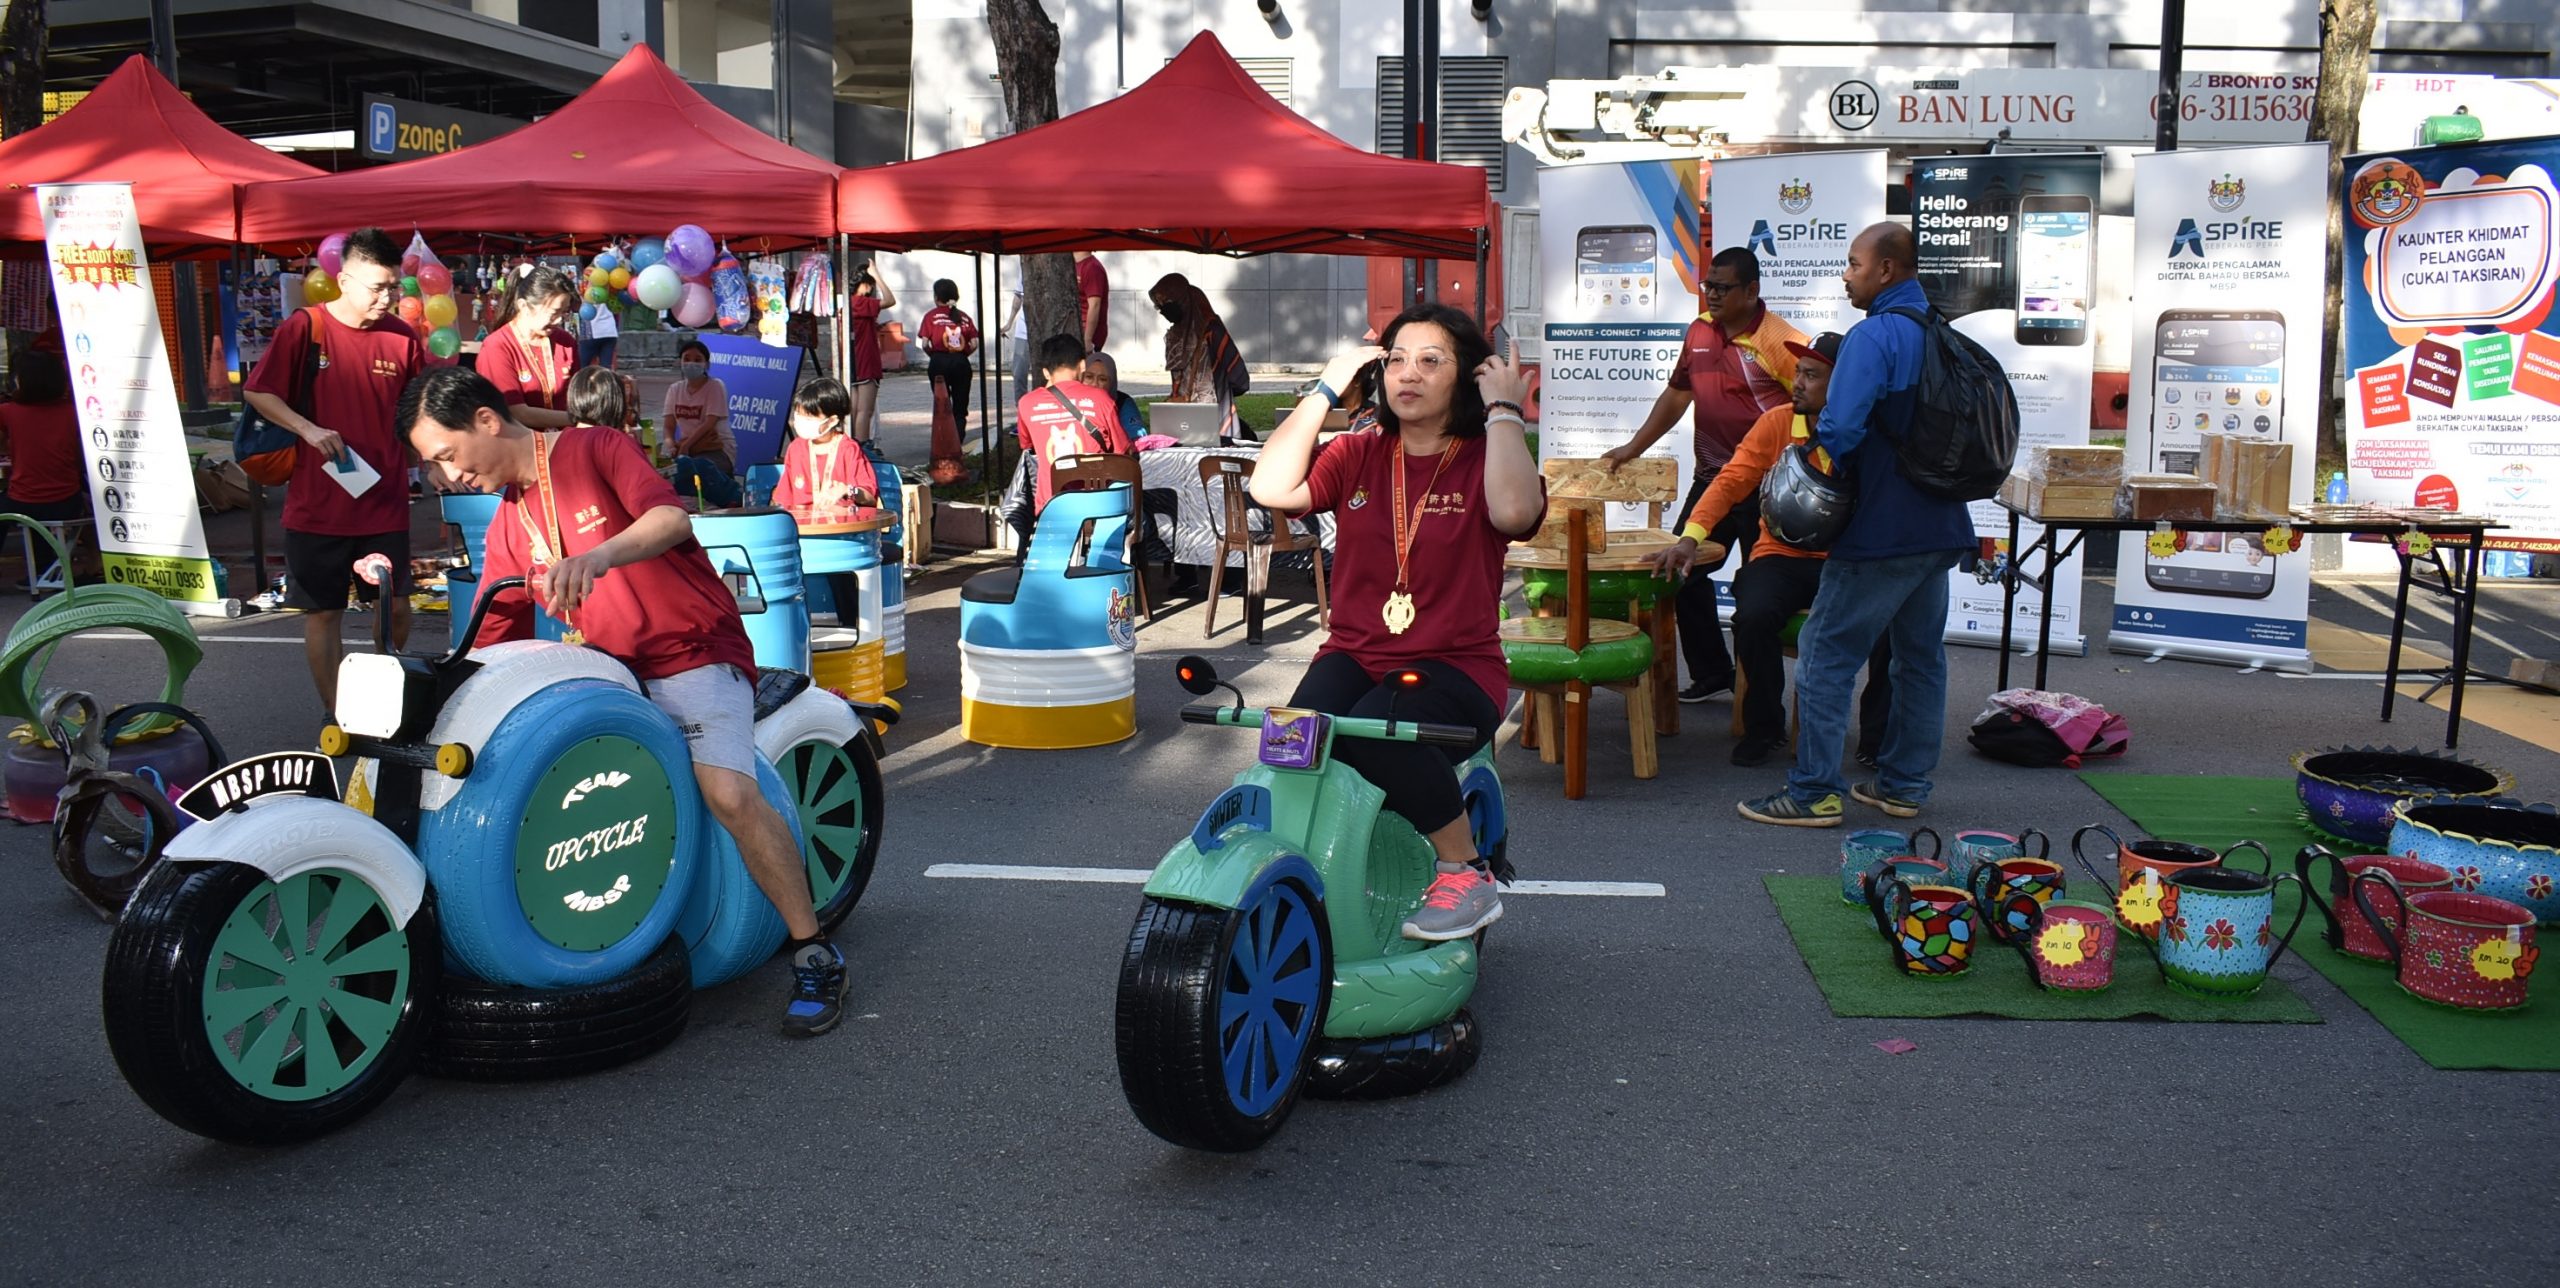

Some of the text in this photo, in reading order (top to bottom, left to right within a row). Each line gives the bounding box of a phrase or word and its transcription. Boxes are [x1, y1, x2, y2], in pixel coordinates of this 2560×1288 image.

[2208, 75, 2286, 89] BRONTO
[2415, 79, 2456, 92] HDT
[1836, 94, 1873, 116] BL
[1898, 94, 2075, 123] BAN LUNG
[375, 111, 462, 153] P zone C
[1920, 195, 1968, 211] Hello
[1919, 213, 2008, 231] Seberang
[1919, 231, 1971, 246] Perai!
[2398, 225, 2529, 247] KAUNTER KHIDMAT
[87, 250, 112, 264] BODY
[2420, 248, 2505, 265] PELANGGAN
[1760, 260, 1782, 268] OKAI
[2168, 260, 2281, 270] TEROKAI PENGALAMAN
[2158, 271, 2290, 280] DIGITAL BAHARU BERSAMA
[2402, 267, 2525, 288] (CUKAI TAKSIRAN)
[1793, 310, 1829, 319] SEKARANG
[1552, 328, 1681, 337] INNOVATE CONNECT INSPIRE
[1553, 348, 1678, 361] THE FUTURE OF
[2434, 352, 2447, 362] SESI
[732, 354, 766, 369] CARNIVAL
[768, 358, 787, 371] MALL
[2417, 357, 2456, 377] RUNDINGAN
[1552, 368, 1672, 381] LOCAL COUNCI
[2367, 373, 2397, 384] SEMAKAN
[2375, 385, 2391, 394] DATA
[2412, 379, 2450, 397] KONSULTASI
[729, 394, 778, 415] CAR PARK
[1558, 394, 1586, 403] Creating
[1617, 395, 1638, 403] digital
[2375, 394, 2394, 404] CUKAI
[1586, 411, 1606, 419] digital
[2371, 404, 2400, 415] TAKSIRAN
[731, 413, 766, 433] ZONE A
[1558, 426, 1594, 434] Digitalising
[2470, 443, 2500, 454] TEMUI
[126, 567, 204, 589] 012-407 0933
[211, 758, 314, 808] MBSP 1001
[562, 771, 631, 810] TEAM
[545, 814, 648, 871] UPCYCLE
[564, 874, 632, 912] MBSP
[2143, 898, 2152, 907] 15
[2062, 941, 2072, 950] 10
[2496, 955, 2510, 965] 20
